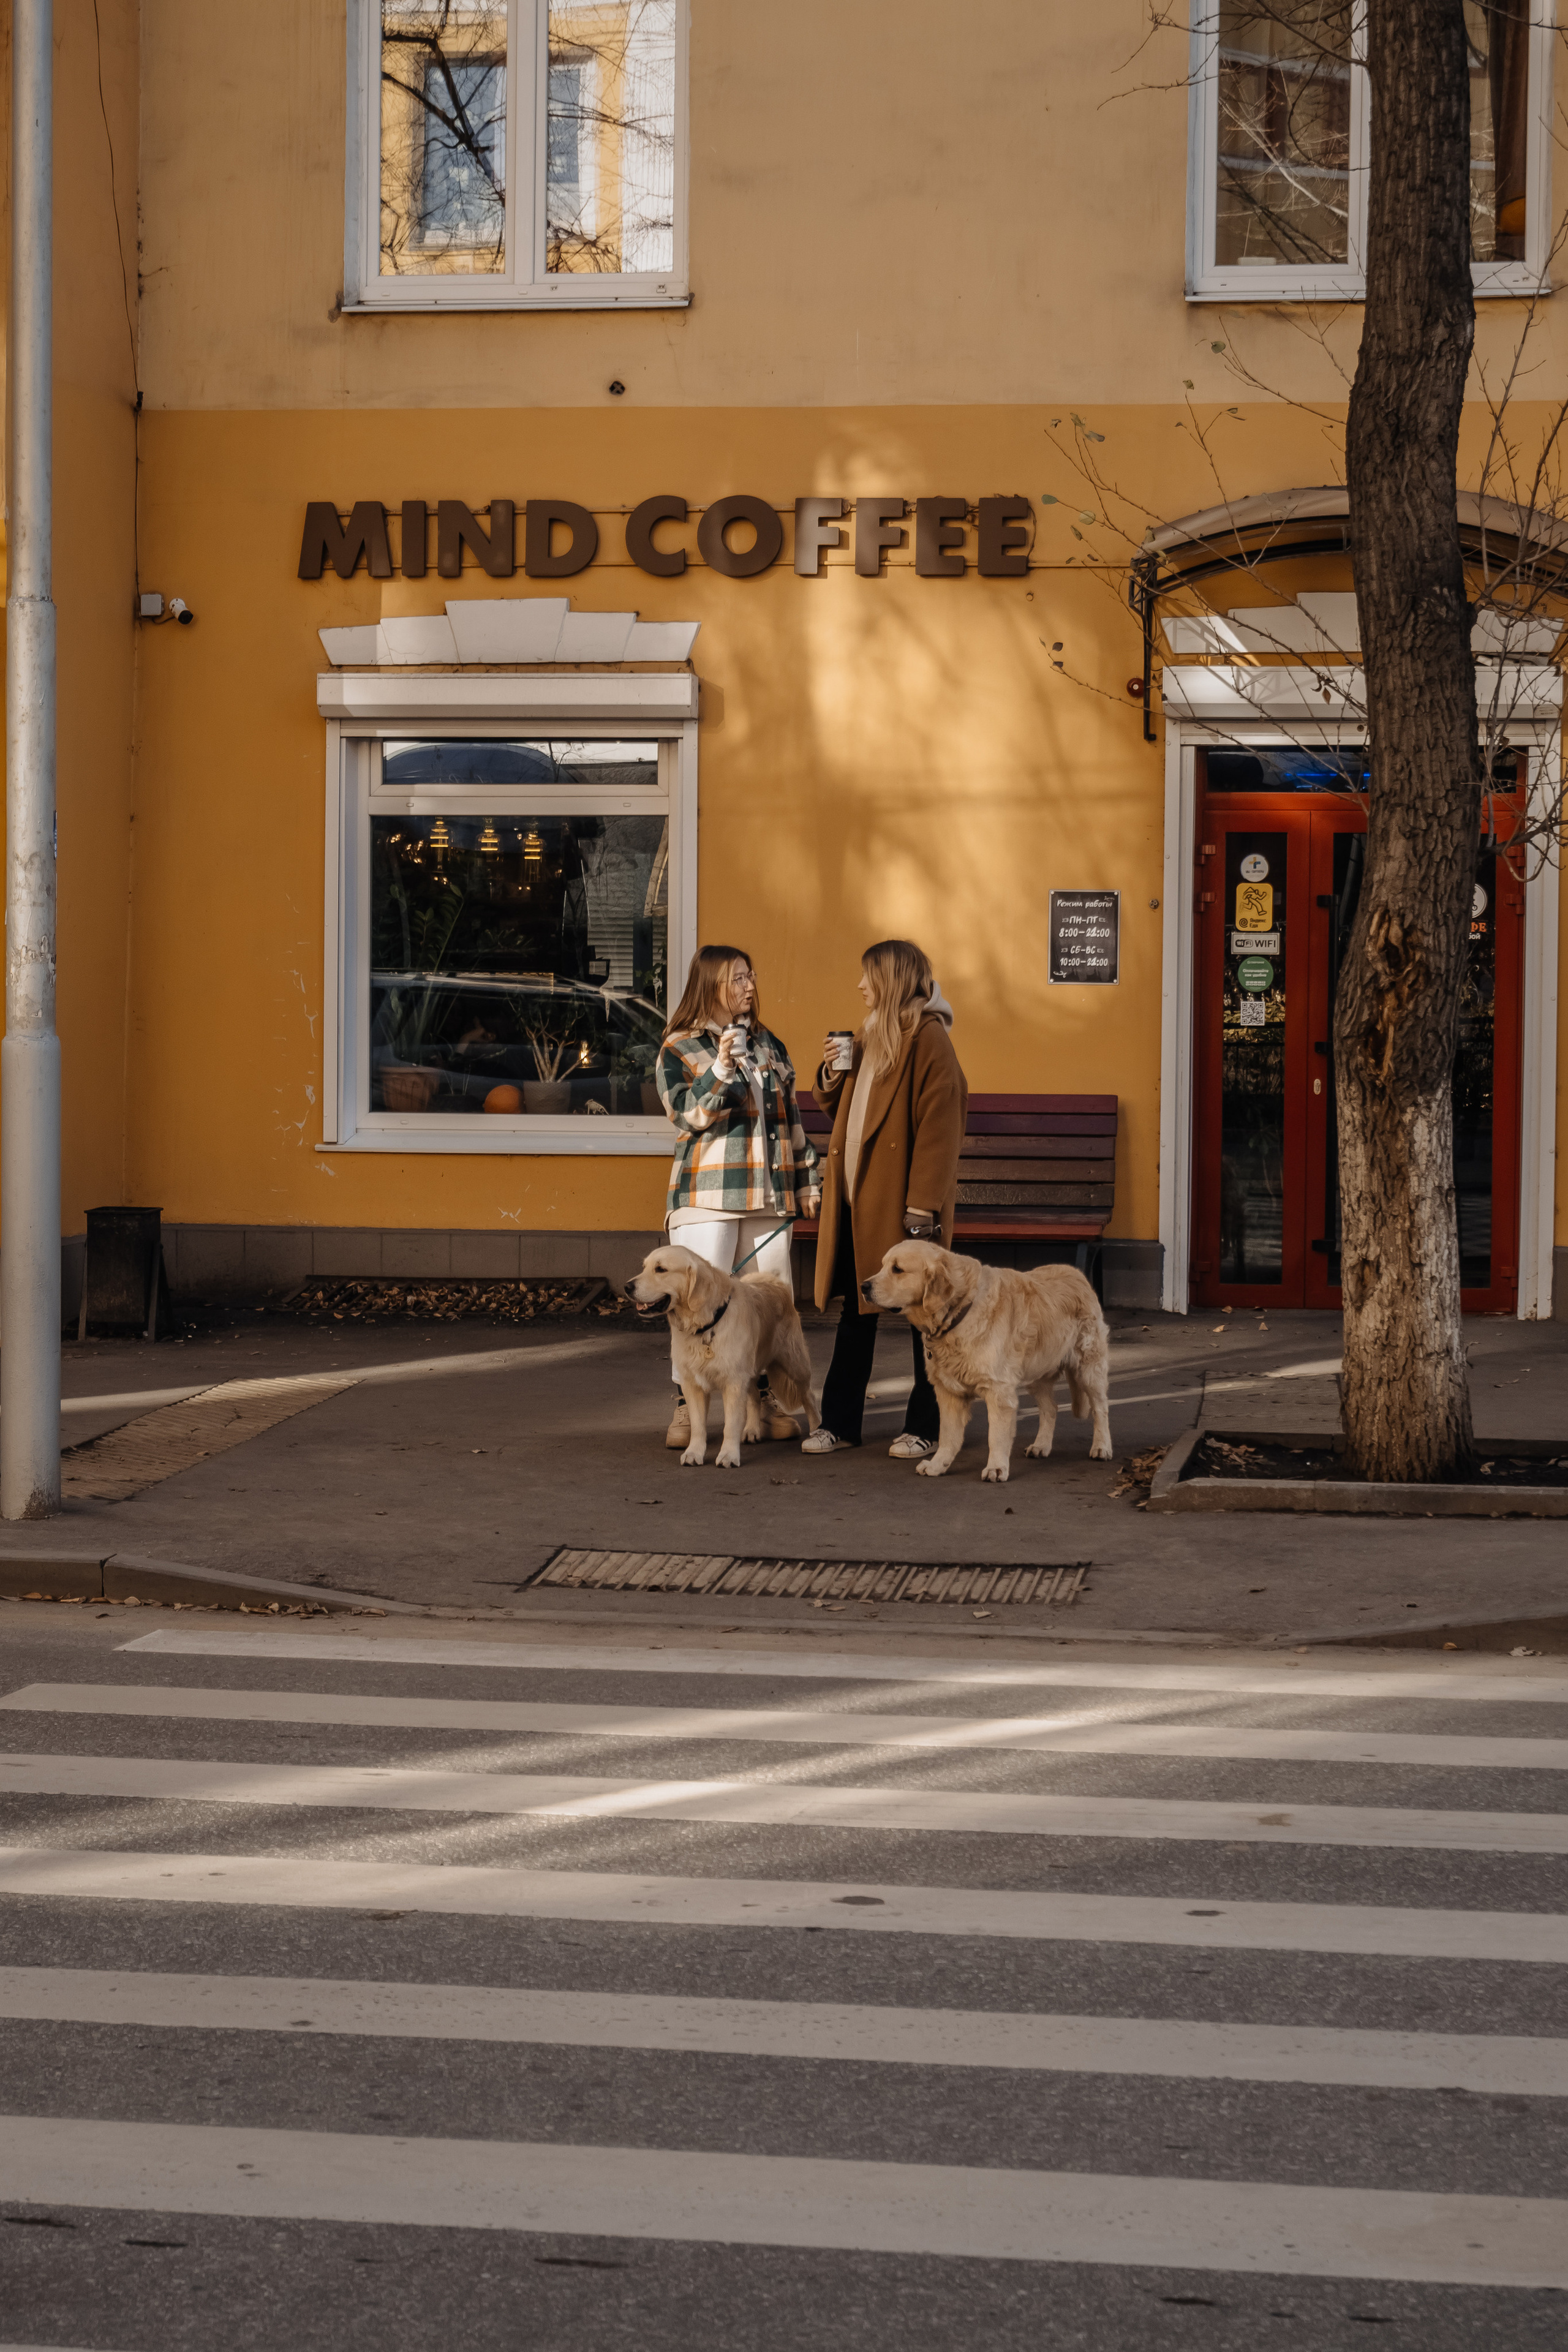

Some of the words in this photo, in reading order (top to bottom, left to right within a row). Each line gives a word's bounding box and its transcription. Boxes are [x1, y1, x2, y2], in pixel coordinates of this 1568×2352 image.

[298, 499, 598, 578] MIND
[625, 494, 1029, 577] COFFEE
[1057, 899, 1083, 908] Режим
[1085, 899, 1112, 909] работы
